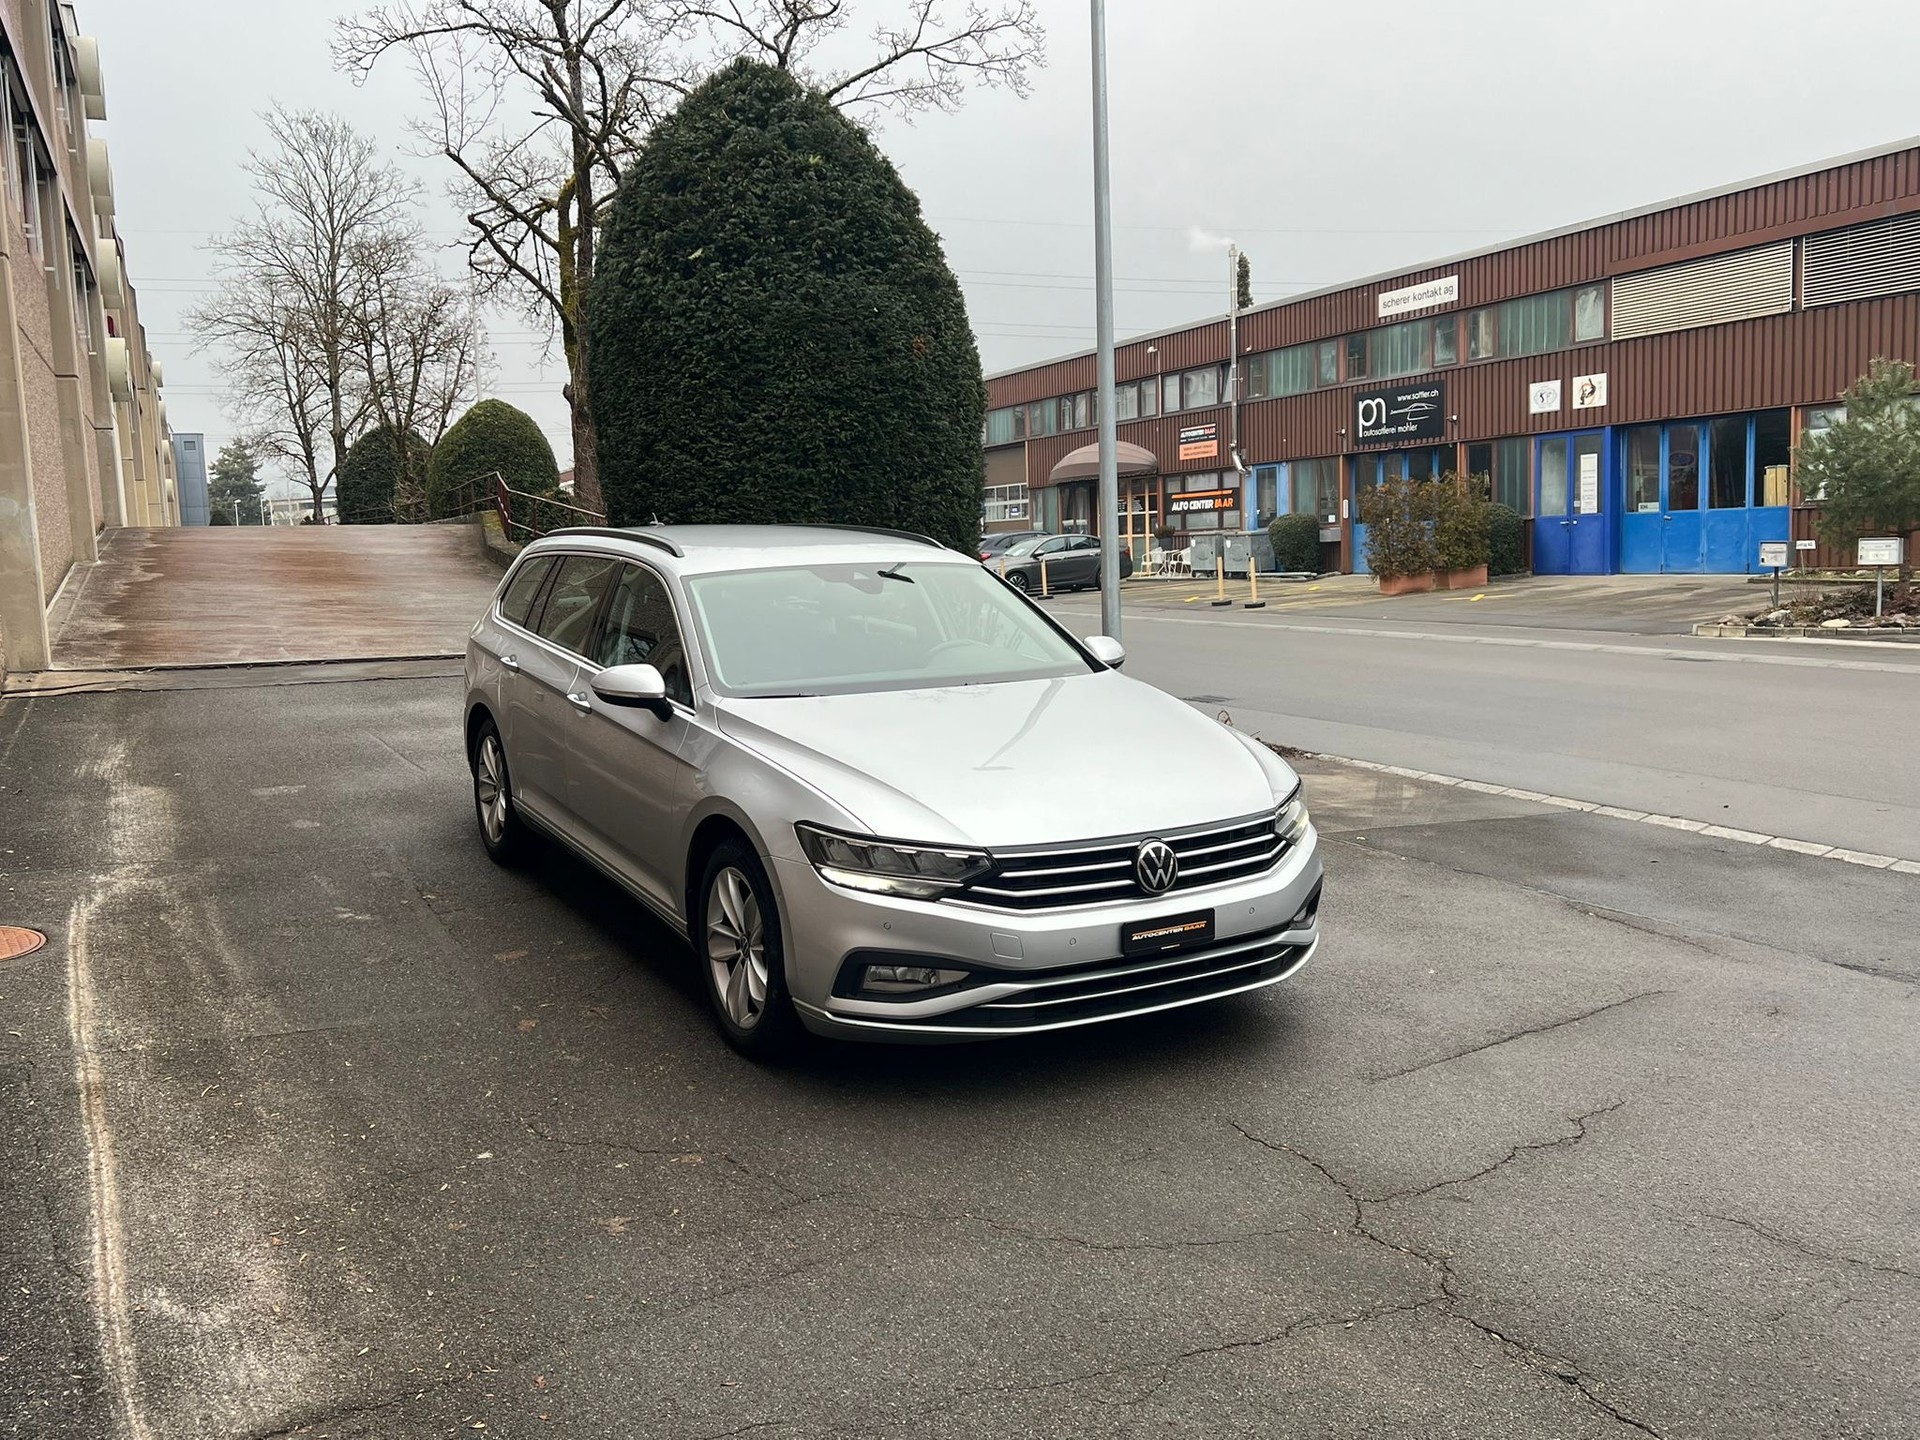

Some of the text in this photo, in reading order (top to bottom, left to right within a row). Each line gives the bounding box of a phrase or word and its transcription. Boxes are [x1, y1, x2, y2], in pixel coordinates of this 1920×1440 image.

[1382, 285, 1454, 309] scherer kontakt ag
[1131, 923, 1206, 940] AUTOCENTER BAAR
